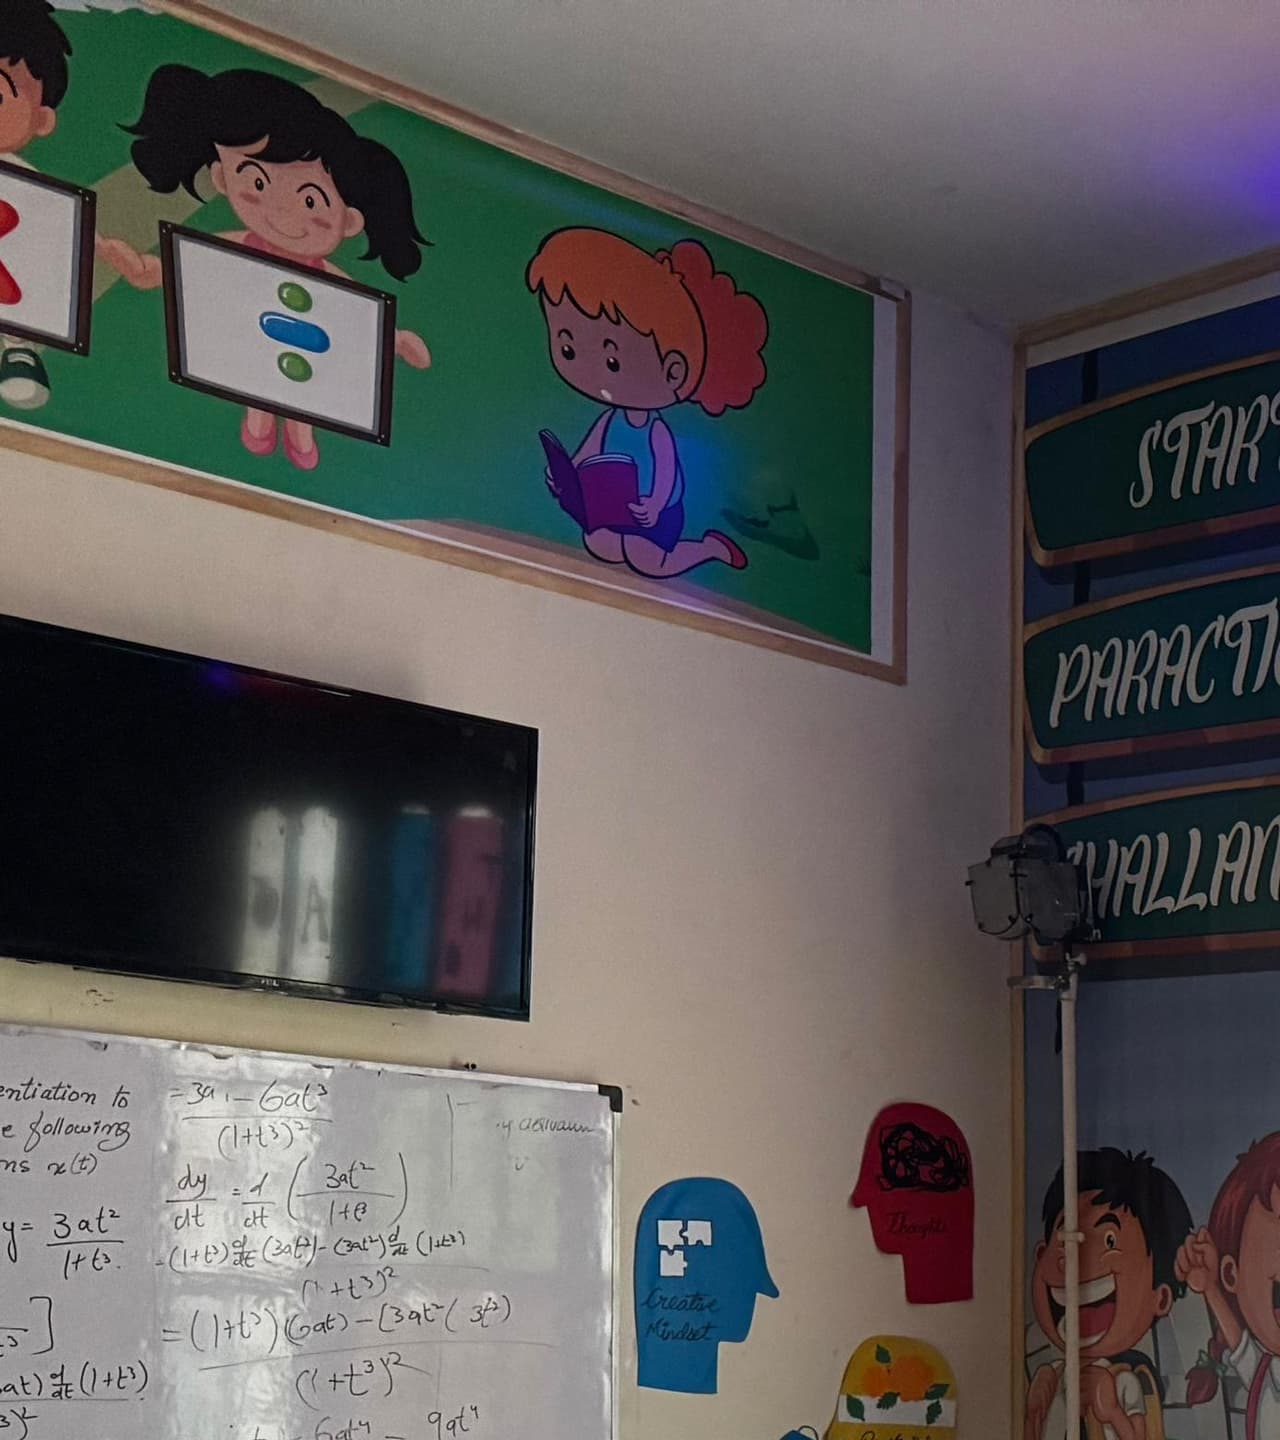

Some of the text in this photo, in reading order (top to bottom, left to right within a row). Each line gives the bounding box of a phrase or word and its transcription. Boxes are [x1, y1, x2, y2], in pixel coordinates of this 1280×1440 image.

[112, 1085, 130, 1108] to
[24, 1111, 131, 1152] following
[641, 1287, 719, 1312] Creative
[645, 1318, 719, 1341] Mindset
